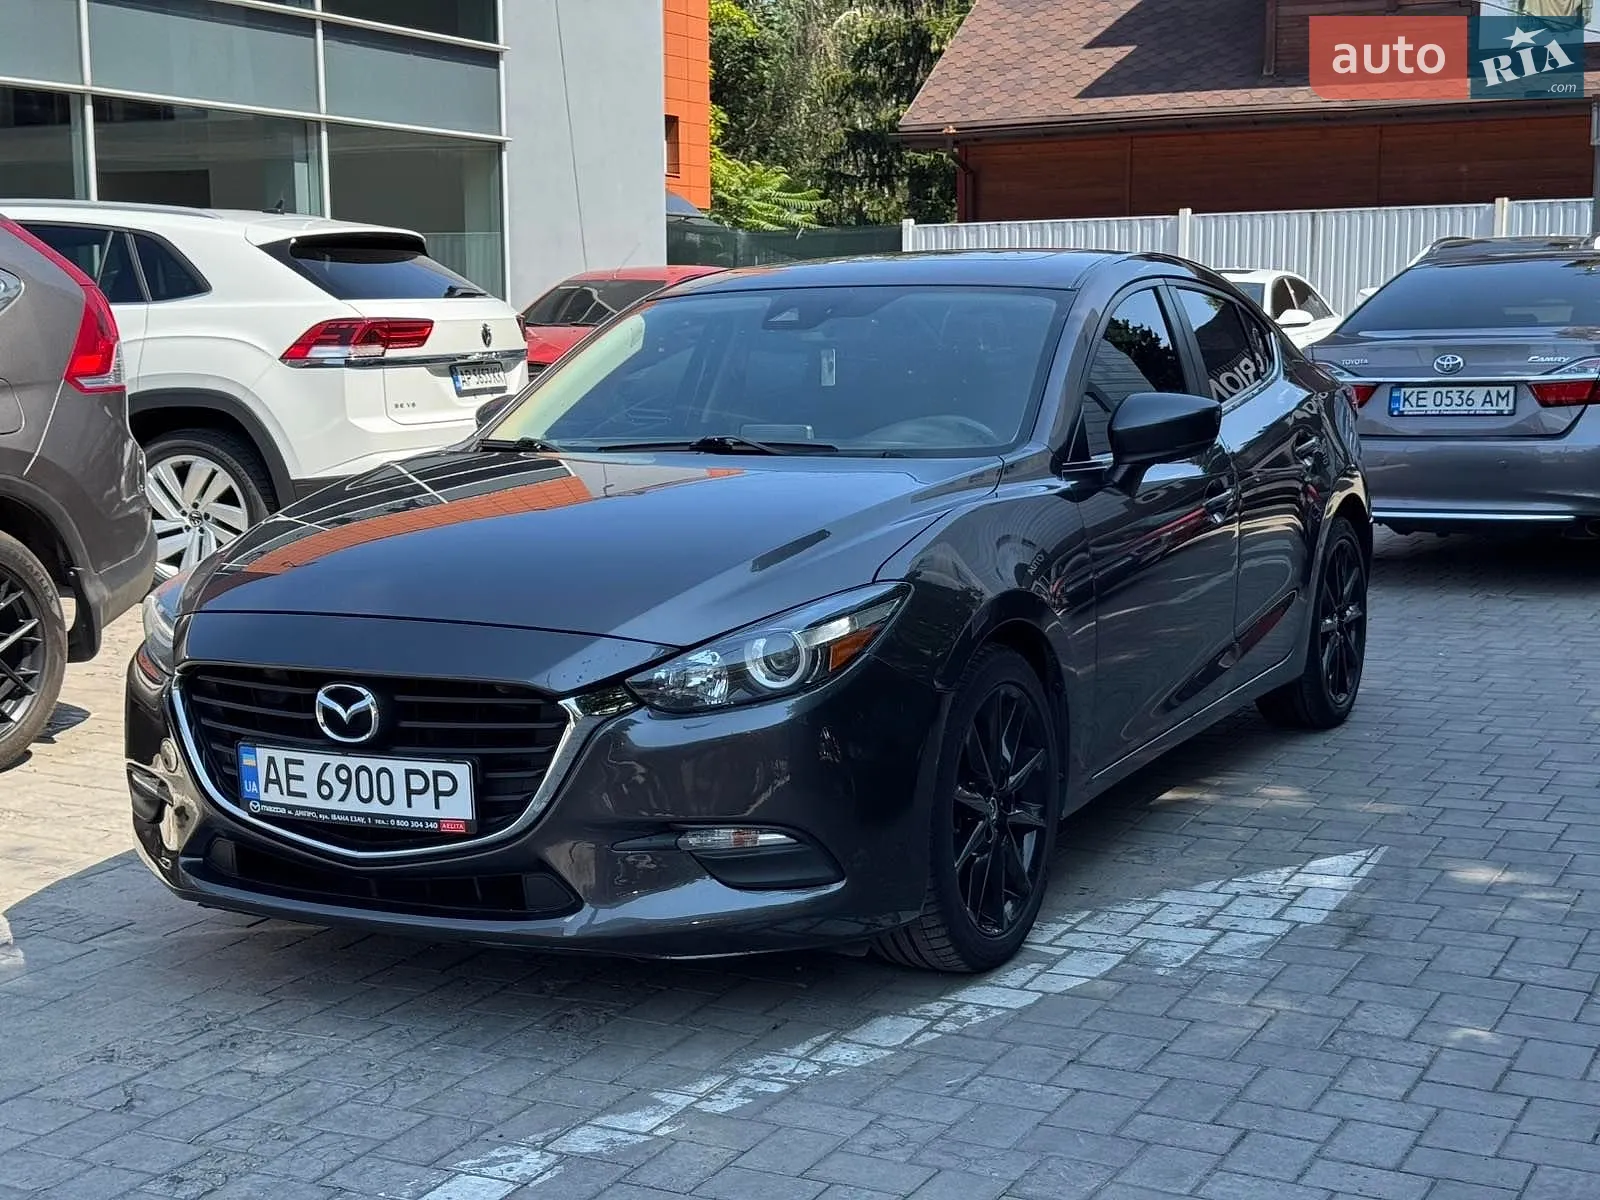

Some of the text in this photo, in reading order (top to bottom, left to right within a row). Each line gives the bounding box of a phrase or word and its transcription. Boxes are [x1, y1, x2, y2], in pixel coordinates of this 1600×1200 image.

[1528, 355, 1570, 363] CAMRY
[1402, 390, 1510, 408] KE 0536 AM
[244, 780, 259, 793] UA
[264, 755, 458, 810] AE 6900 PP
[261, 805, 286, 814] mazda
[425, 821, 438, 829] 340
